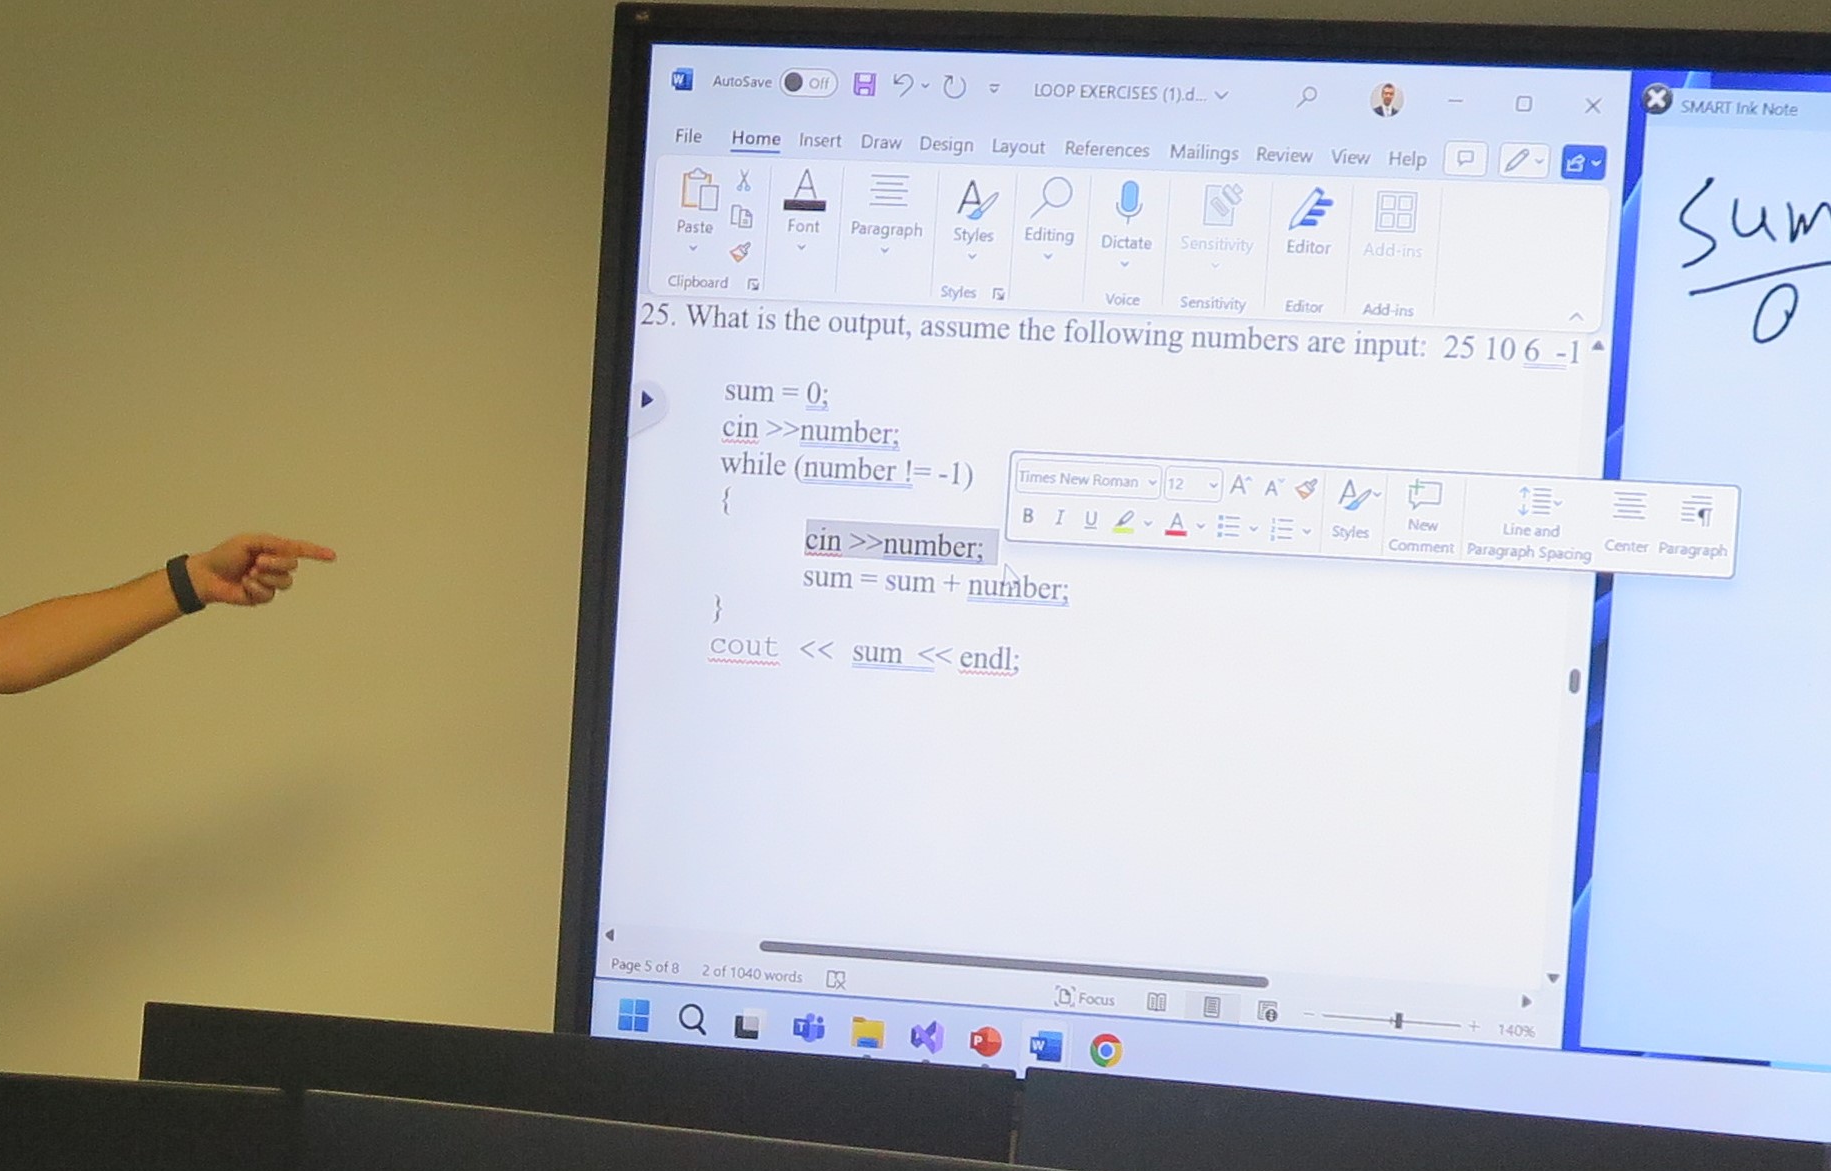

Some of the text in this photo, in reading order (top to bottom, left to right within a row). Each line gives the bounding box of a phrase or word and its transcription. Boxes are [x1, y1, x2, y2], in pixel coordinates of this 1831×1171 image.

[712, 75, 773, 89] AutoSave
[809, 76, 831, 90] Off
[1034, 83, 1074, 98] LOOP
[1080, 84, 1157, 100] EXERCISES
[1680, 99, 1799, 117] SMART Ink Note
[675, 127, 1428, 170] File Home Insert Draw Design Layout References Mailings Review View Help
[677, 220, 714, 234] Paste
[787, 218, 820, 234] Font
[851, 221, 923, 240] Paragraph
[953, 228, 995, 244] Styles
[1025, 226, 1075, 245] Editing
[1101, 234, 1153, 250] Dictate
[1180, 236, 1255, 255] Sensitivity
[1286, 238, 1332, 255] Editor
[1363, 242, 1423, 258] Add-ins
[668, 275, 729, 290] Clipboard
[940, 285, 977, 301] Styles
[1105, 293, 1141, 306] Voice
[1179, 295, 1247, 314] Sensitivity
[1285, 300, 1324, 314] Editor
[1362, 302, 1415, 318] Add-ins
[640, 302, 1580, 365] 25. What is the output, assume the following numbers are input: 25 10 6 -1
[724, 380, 829, 408] sum = 0;
[723, 414, 900, 449] cin >>number;
[721, 450, 974, 493] while (number != -1)
[1019, 470, 1139, 488] Times New Roman
[1168, 478, 1185, 491] 12
[721, 486, 732, 516] {
[1332, 525, 1370, 542] Styles
[1408, 519, 1438, 533] New
[1503, 523, 1561, 538] Line and
[805, 527, 984, 563] cin >>number;
[1388, 539, 1455, 555] Comment
[1605, 539, 1649, 554] Center
[1658, 541, 1729, 559] Paragraph
[1467, 544, 1593, 564] Paragraph Spacing
[803, 569, 1069, 603] sum = sum + number;
[713, 594, 723, 624] }
[710, 636, 779, 657] cout
[799, 640, 834, 659] <<
[852, 643, 902, 664] sum
[959, 647, 1020, 675] endl;
[611, 959, 680, 975] Page 5 of 8
[702, 965, 803, 984] 2 of 1040 words
[1078, 992, 1116, 1008] Focus
[1498, 1024, 1537, 1038] 140%
